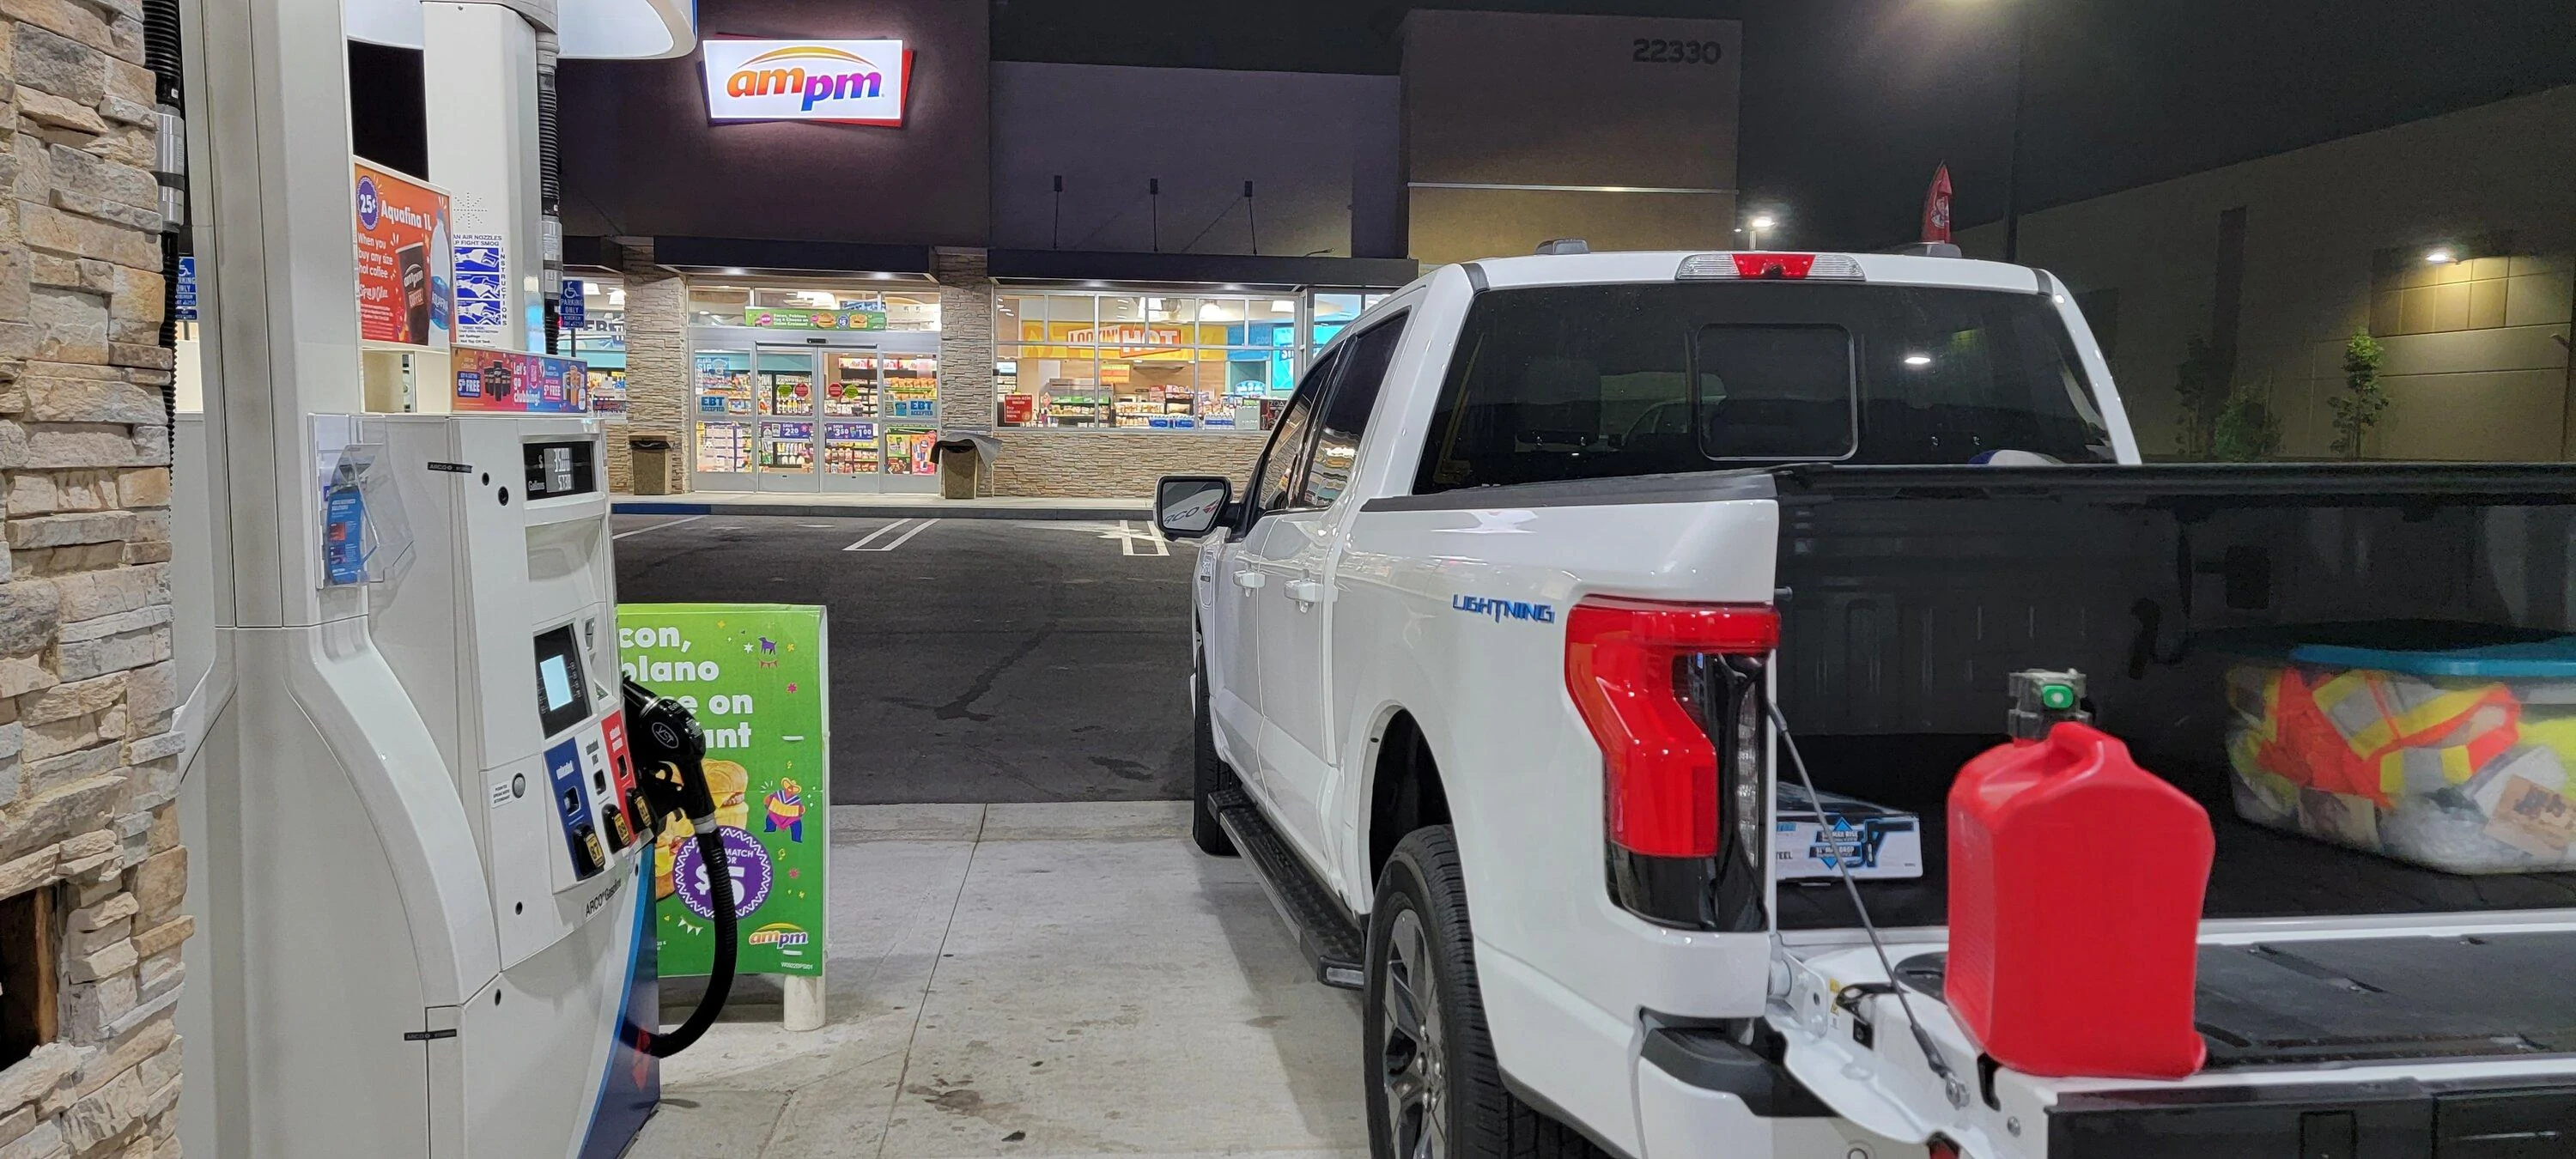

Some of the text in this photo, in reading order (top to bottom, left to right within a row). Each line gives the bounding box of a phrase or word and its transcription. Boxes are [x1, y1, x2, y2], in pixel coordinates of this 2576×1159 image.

[1633, 39, 1721, 64] 22330
[727, 67, 882, 112] ampm
[360, 194, 376, 214] 25¢
[381, 200, 432, 231] Aquafina 1L
[357, 232, 386, 250] When you
[358, 249, 393, 266] buy any size
[358, 263, 388, 279] hot coffee
[1122, 331, 1177, 353] HOT
[513, 361, 526, 375] Let's
[697, 364, 712, 373] SIP
[466, 379, 480, 392] FREE
[513, 378, 521, 391] go
[550, 385, 561, 397] FREE
[513, 390, 541, 406] clubbing!
[701, 397, 725, 406] EBT
[910, 401, 933, 410] EBT
[527, 480, 545, 492] Gallons
[1452, 594, 1556, 624] LIGHTNING
[619, 627, 692, 653] con,
[708, 694, 753, 714] on
[590, 842, 601, 859] 87
[695, 863, 745, 908] $5
[586, 891, 604, 918] ARCO
[749, 930, 809, 950] ampm
